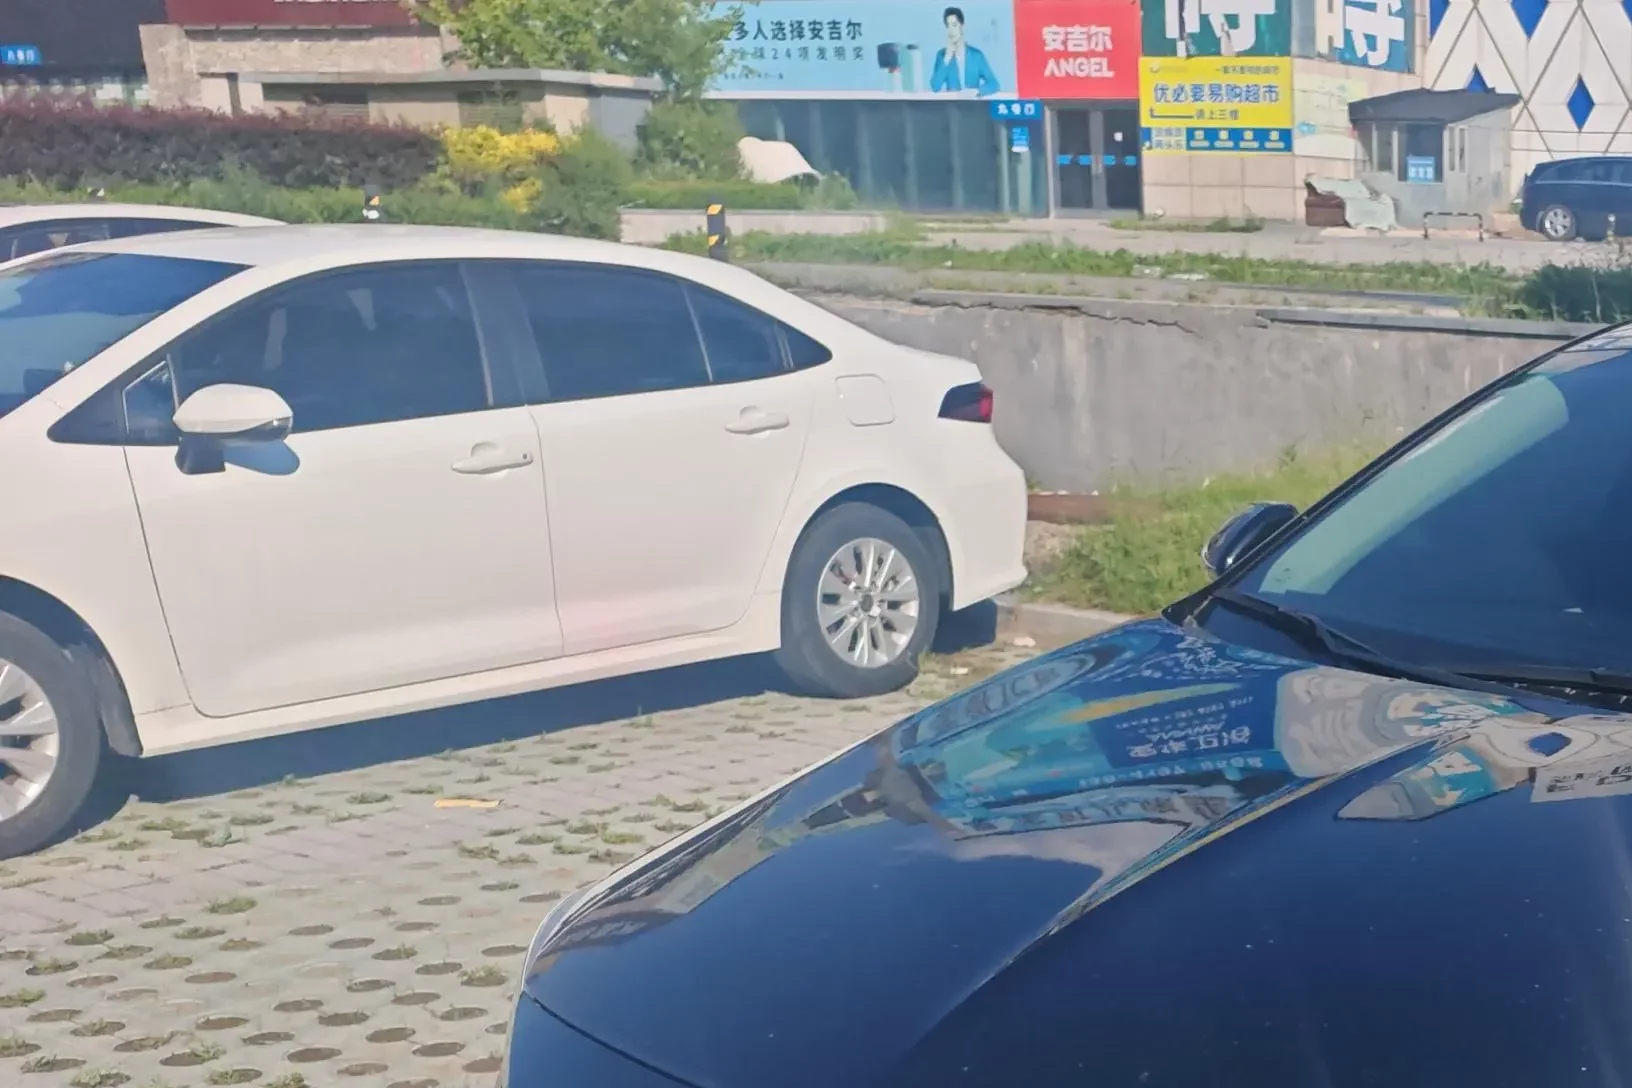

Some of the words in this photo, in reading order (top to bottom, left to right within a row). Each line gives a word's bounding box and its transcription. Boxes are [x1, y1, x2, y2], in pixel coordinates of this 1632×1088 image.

[724, 20, 863, 41] 多人选择安吉尔
[1042, 25, 1113, 51] 安吉尔
[1044, 58, 1115, 78] ANGEL
